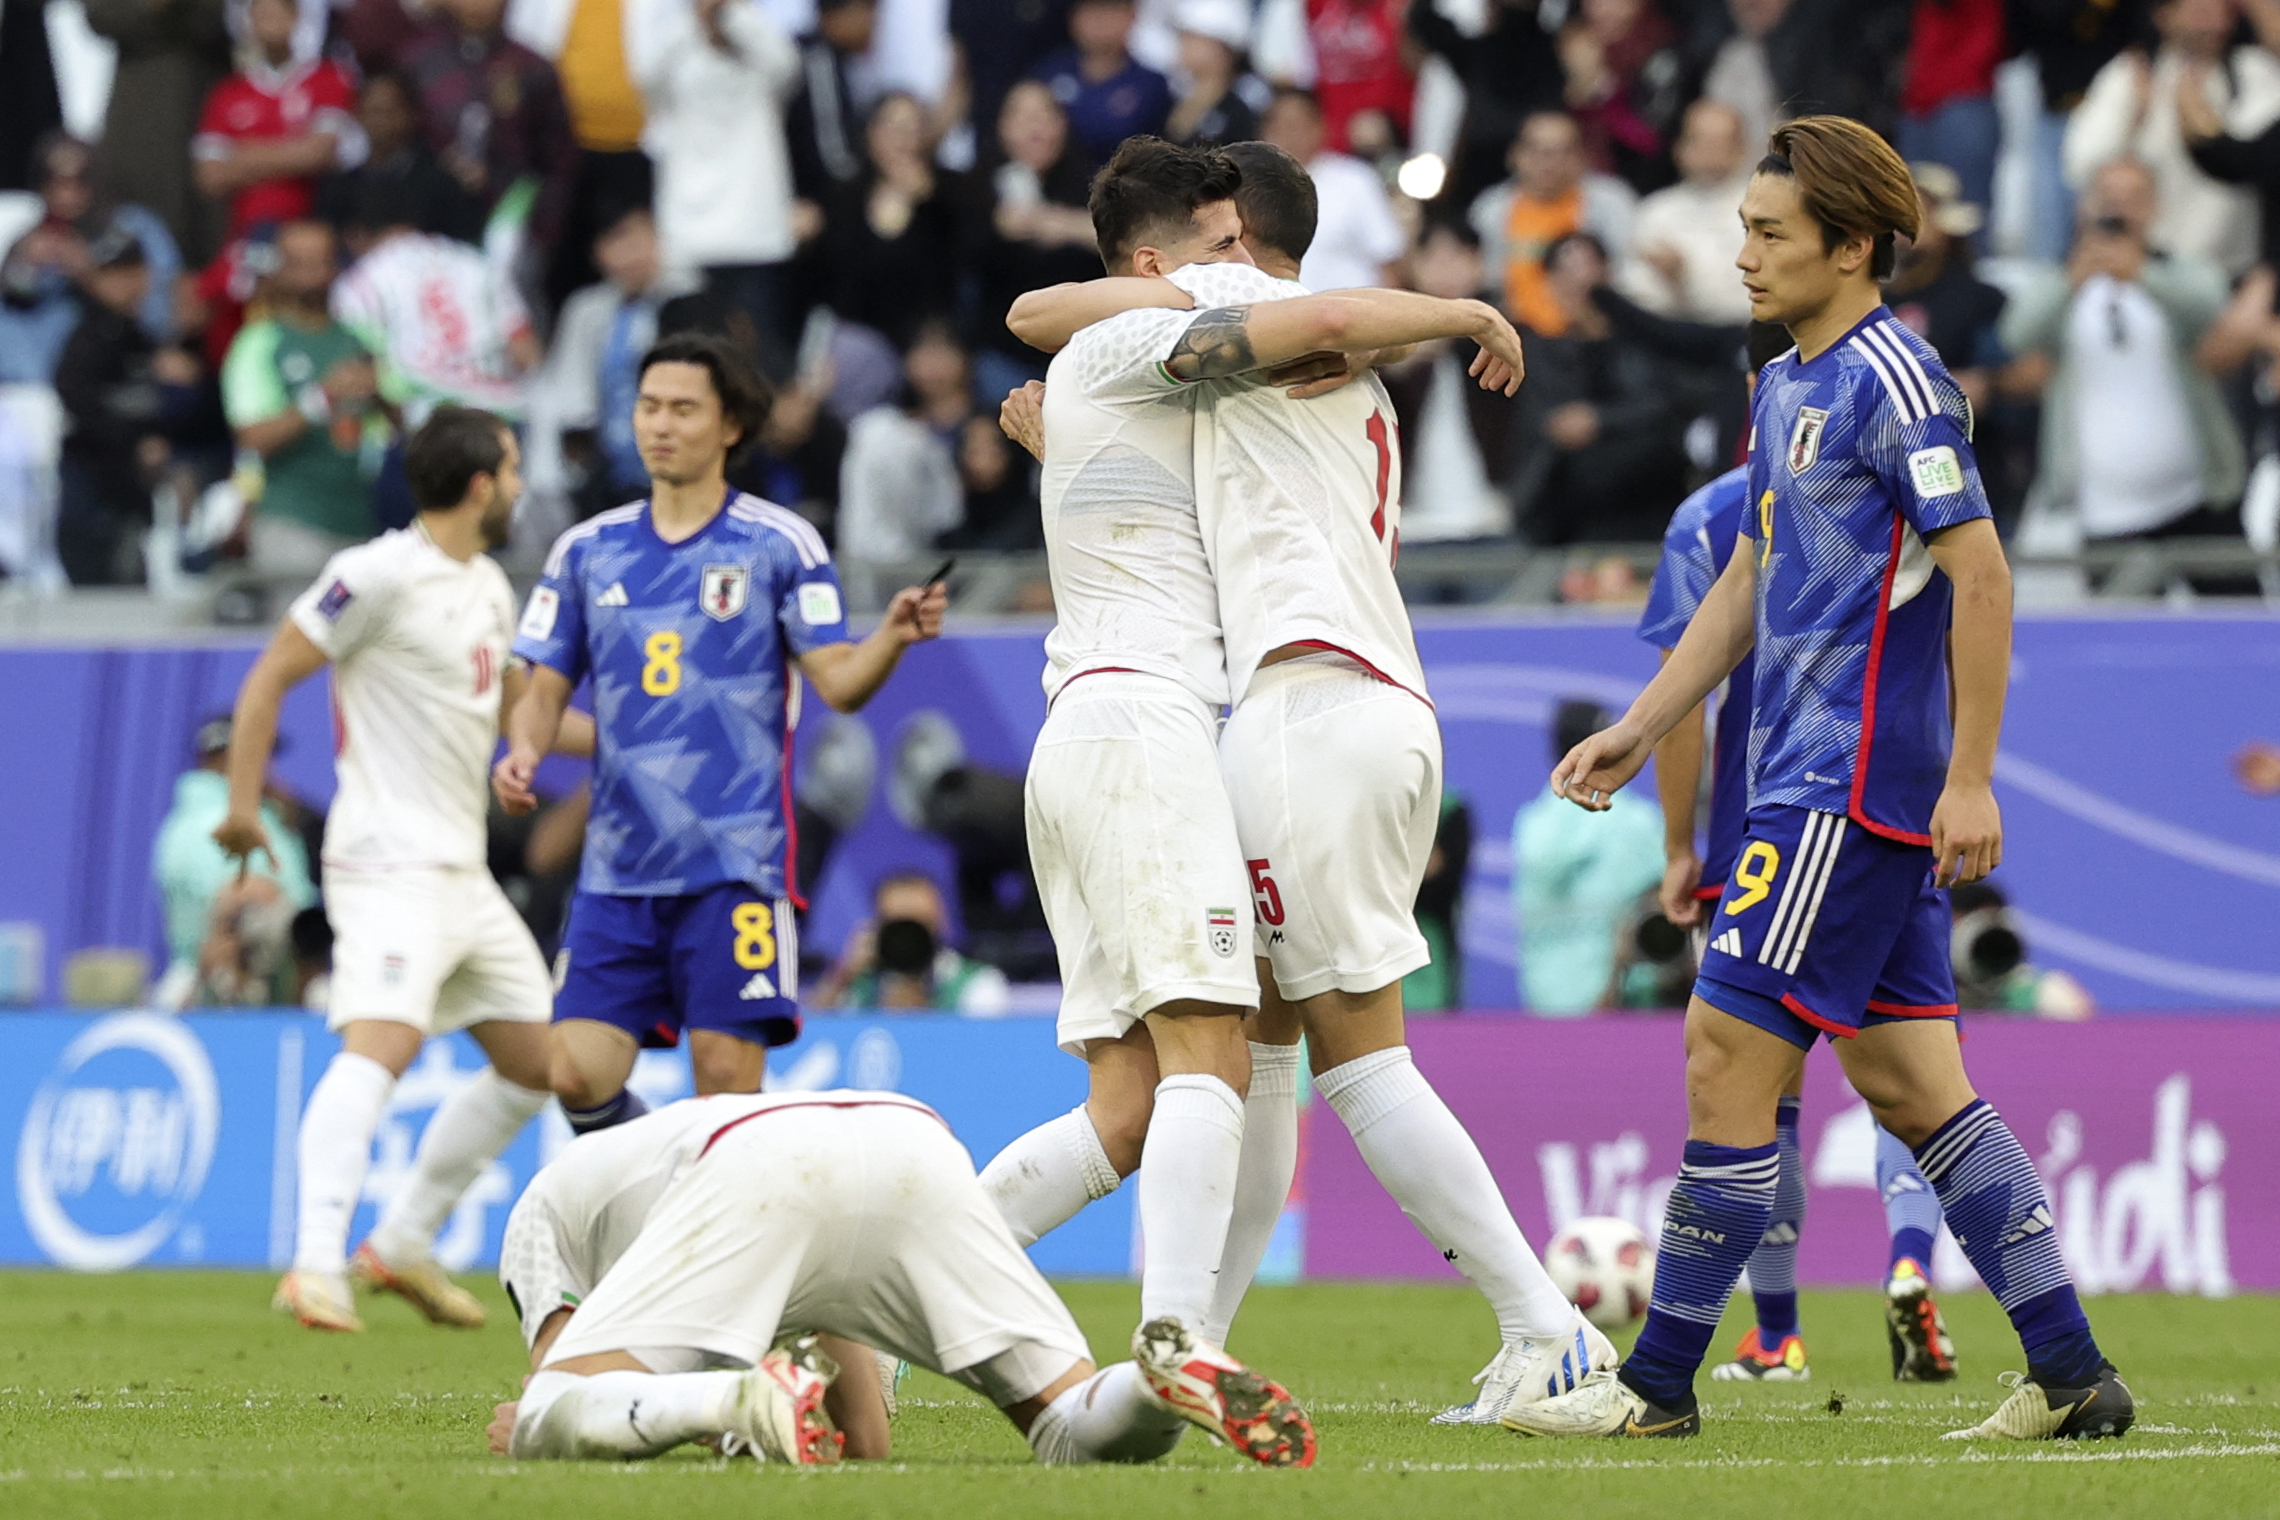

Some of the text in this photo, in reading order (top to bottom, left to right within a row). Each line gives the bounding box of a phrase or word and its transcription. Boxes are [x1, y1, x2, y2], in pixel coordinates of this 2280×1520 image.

[1366, 407, 1401, 571] 1
[1917, 456, 1936, 466] AFC
[1919, 462, 1952, 479] LIVE
[1761, 489, 1774, 568] 9
[641, 630, 682, 697] 8
[1724, 841, 1780, 916] 9
[731, 902, 776, 970] 8
